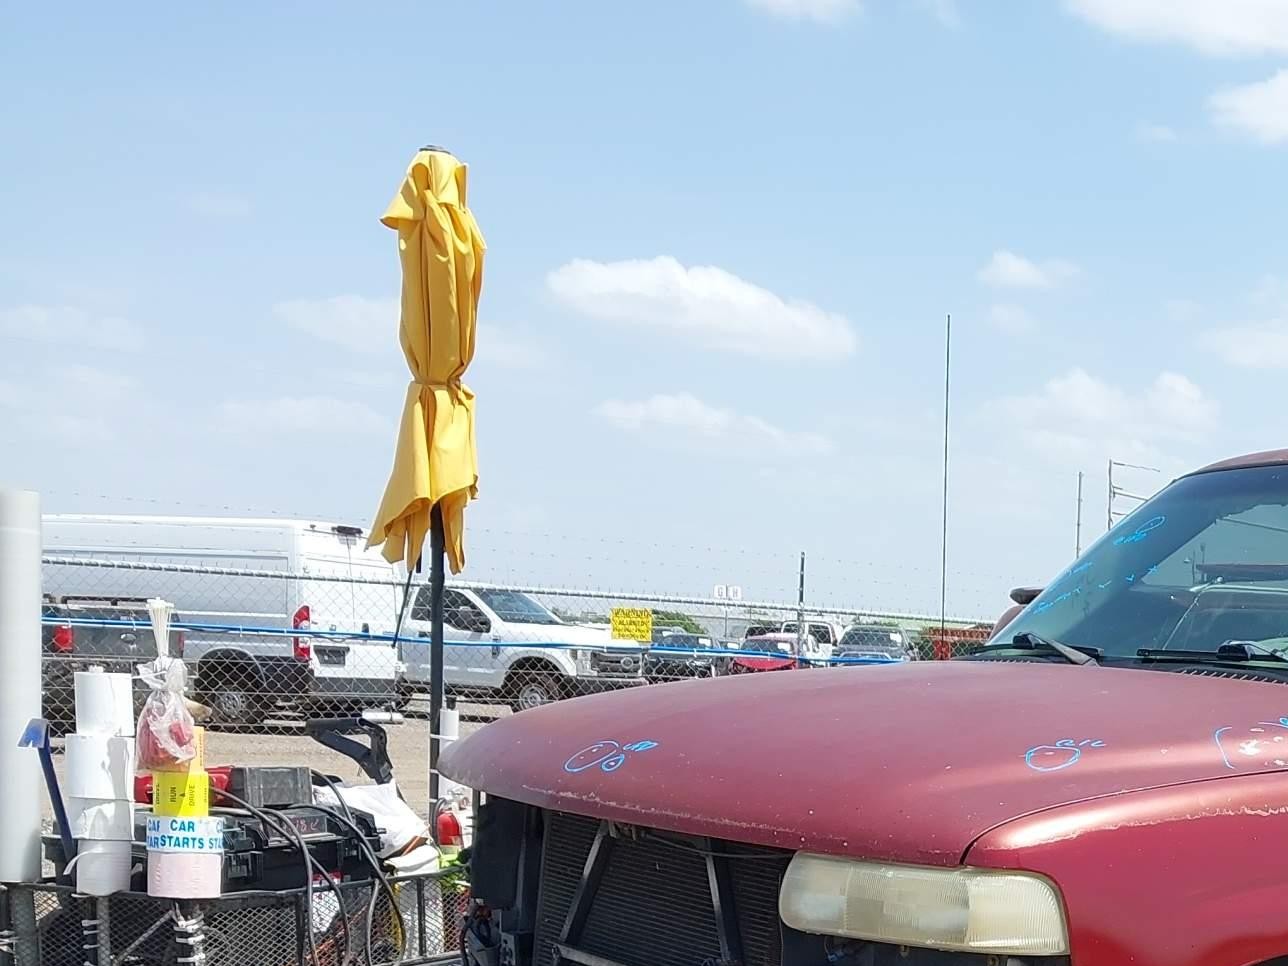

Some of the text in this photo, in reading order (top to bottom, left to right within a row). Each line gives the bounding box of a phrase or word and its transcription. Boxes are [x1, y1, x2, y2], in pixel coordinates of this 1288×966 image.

[188, 783, 196, 807] DRIVE
[170, 818, 196, 833] CAR
[160, 834, 205, 849] STARTS
